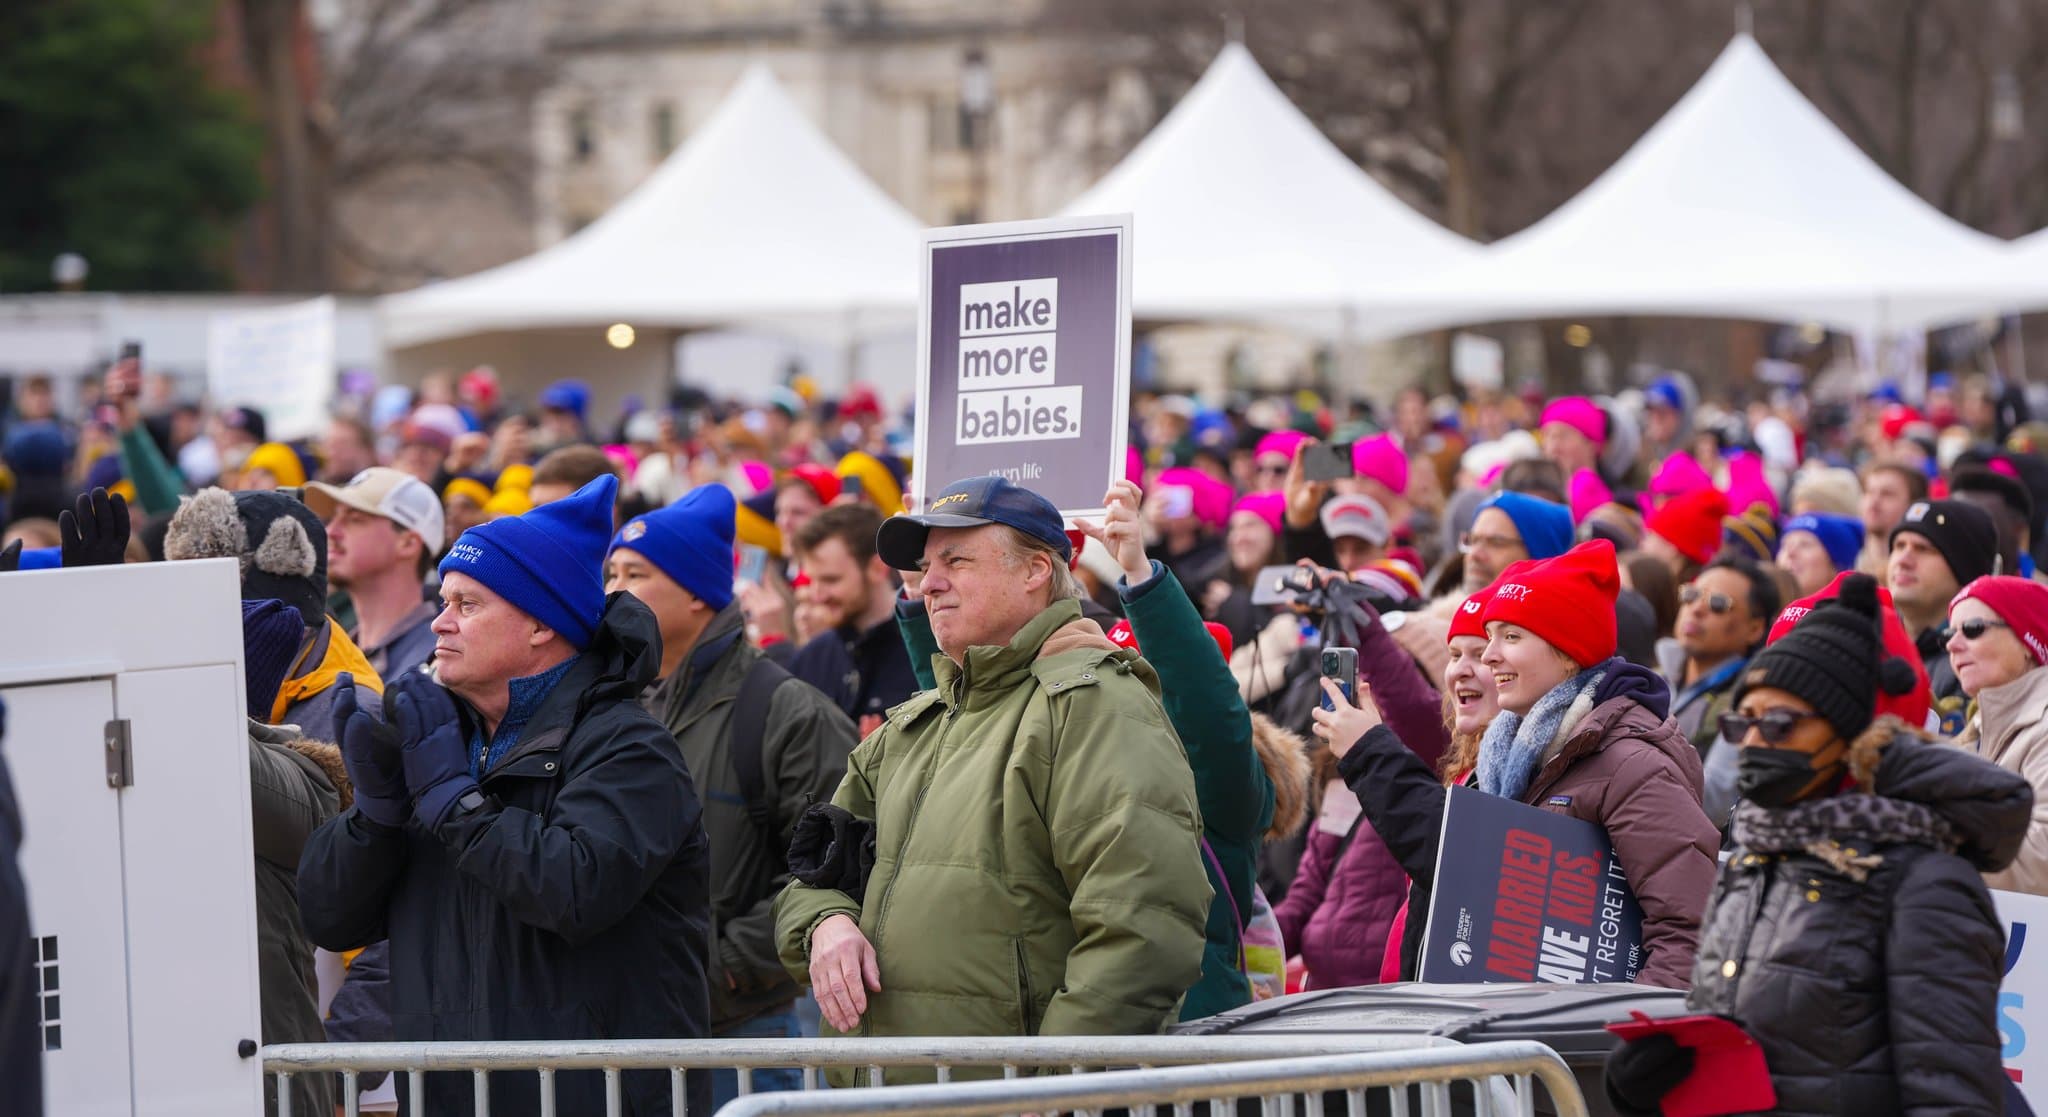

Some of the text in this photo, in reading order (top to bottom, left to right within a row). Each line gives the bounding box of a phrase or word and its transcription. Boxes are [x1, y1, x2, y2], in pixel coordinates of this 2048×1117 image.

[964, 286, 1051, 331] make
[963, 345, 1048, 378] more
[960, 395, 1078, 439] babies.
[1022, 462, 1043, 480] life
[1485, 828, 1553, 982] MARRIED
[1536, 850, 1603, 984] AVE KIDS.
[1595, 882, 1625, 964] REGRET
[1627, 943, 1641, 969] KIRK
